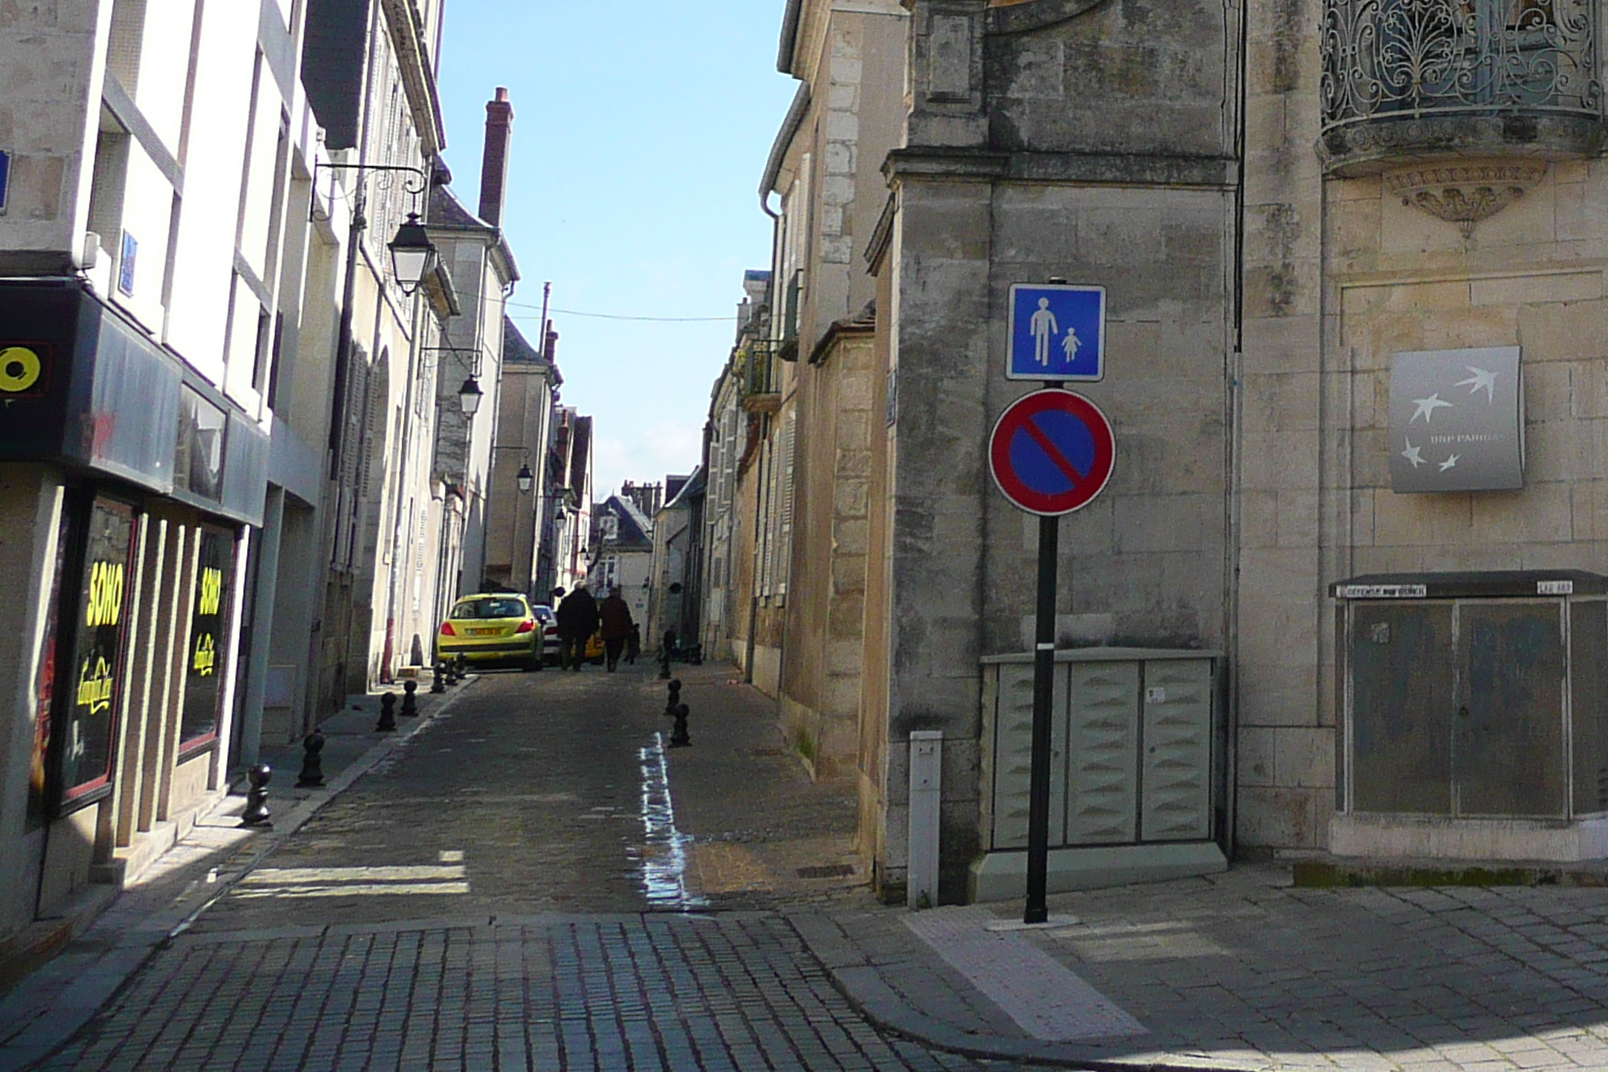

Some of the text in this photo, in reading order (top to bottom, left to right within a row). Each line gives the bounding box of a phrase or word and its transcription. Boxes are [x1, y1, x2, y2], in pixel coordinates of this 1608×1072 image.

[1430, 435, 1455, 444] BNP
[86, 561, 124, 627] SOHO
[199, 566, 222, 615] SOHO
